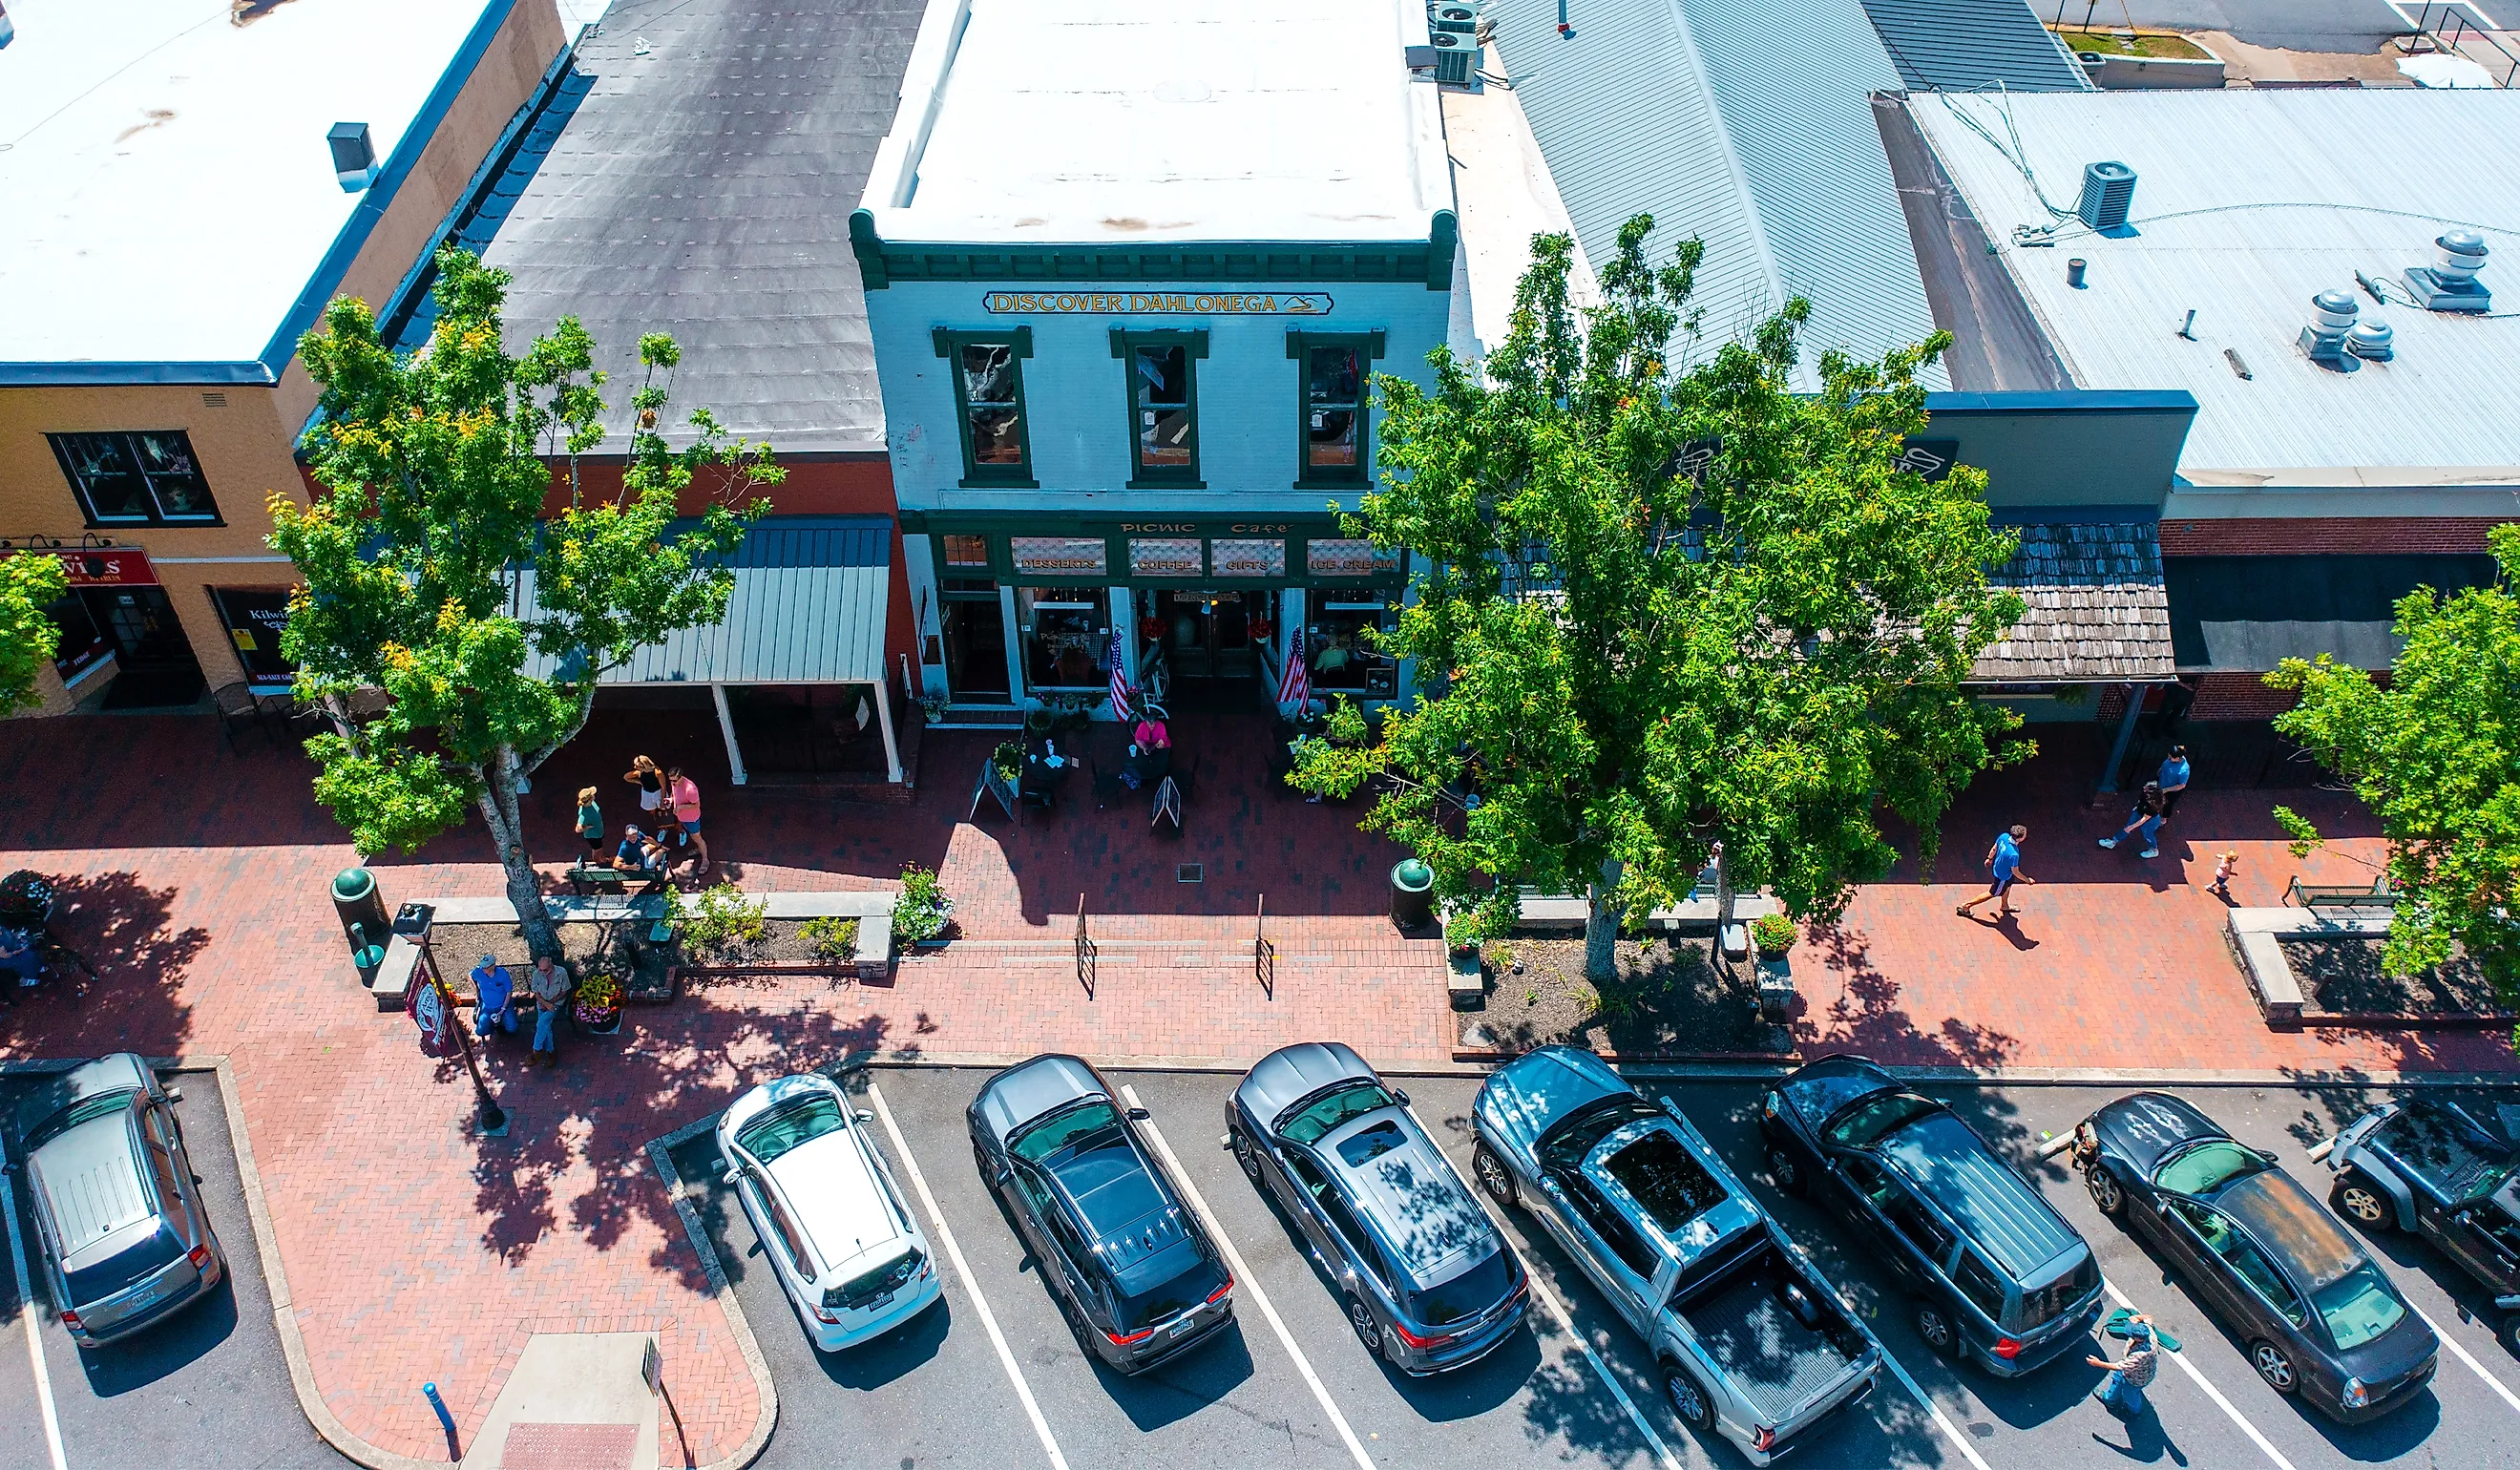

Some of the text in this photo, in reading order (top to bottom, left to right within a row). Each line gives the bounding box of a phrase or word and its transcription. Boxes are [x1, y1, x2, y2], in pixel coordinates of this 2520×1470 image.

[993, 294, 1277, 312] DISCOVER DAHLONEGA
[1121, 523, 1196, 534] PICNIC
[1021, 558, 1097, 569] DESSERTS
[1137, 560, 1193, 570] COFFEE
[1226, 560, 1269, 571] GIFTS
[1311, 559, 1396, 570] ICE CREAM
[248, 609, 290, 620] Kilwi
